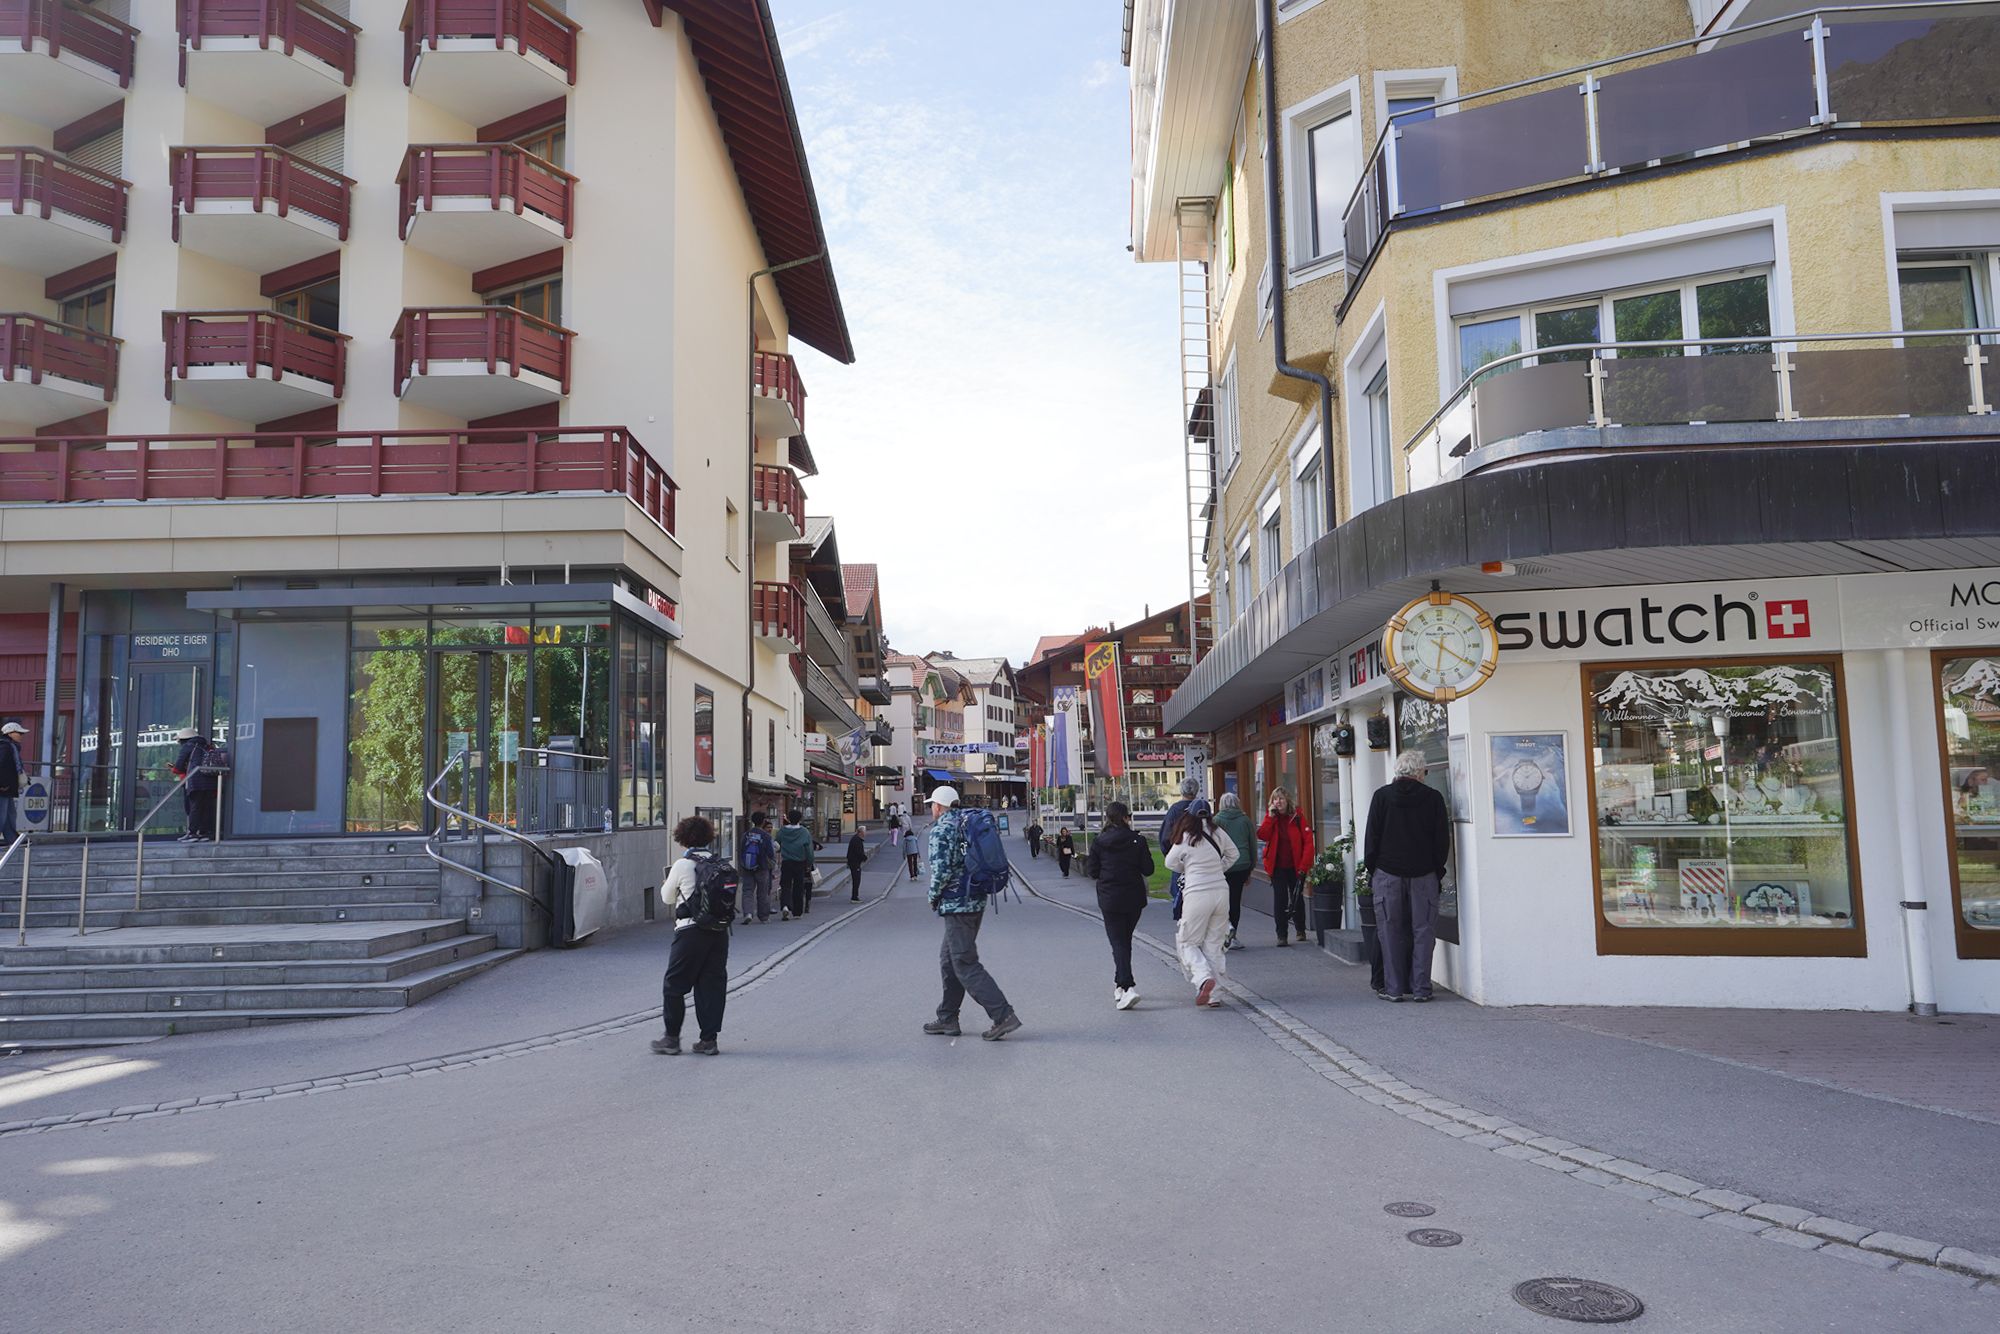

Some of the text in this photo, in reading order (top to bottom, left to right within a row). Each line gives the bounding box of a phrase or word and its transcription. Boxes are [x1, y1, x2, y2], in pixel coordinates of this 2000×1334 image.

[1909, 617, 2000, 632] Official Sw
[135, 635, 208, 646] RESIDENCE EIGER
[162, 647, 180, 657] DHO
[1603, 708, 1657, 722] Willkommen
[1725, 705, 1766, 719] Bienvenue
[929, 744, 967, 754] START
[1136, 753, 1168, 761] Central
